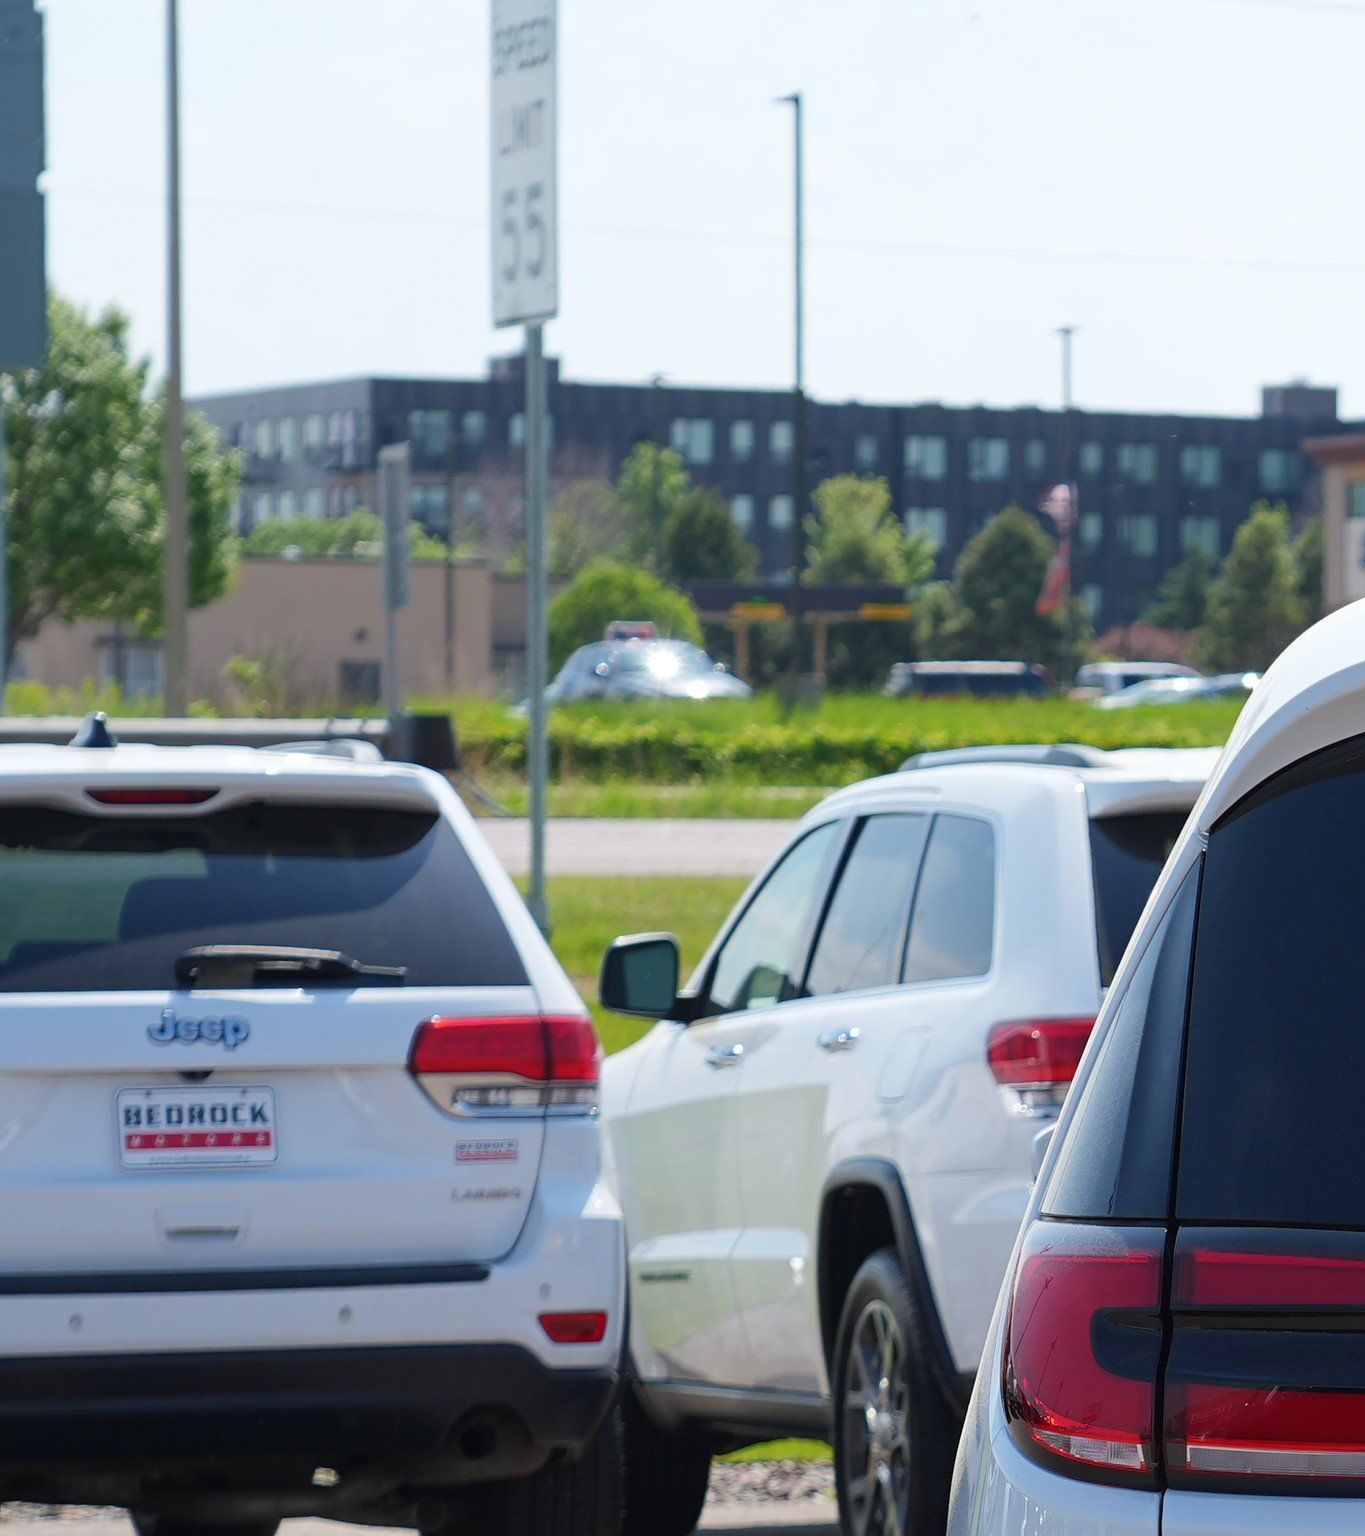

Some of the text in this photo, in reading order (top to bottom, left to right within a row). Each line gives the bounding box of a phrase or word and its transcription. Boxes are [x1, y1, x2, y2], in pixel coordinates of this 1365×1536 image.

[493, 15, 551, 76] SPEED
[499, 98, 546, 156] LIMIT
[502, 181, 545, 284] 55
[147, 1008, 250, 1050] Jeep
[124, 1102, 270, 1127] BEDROCK
[130, 1132, 266, 1147] MOTORS
